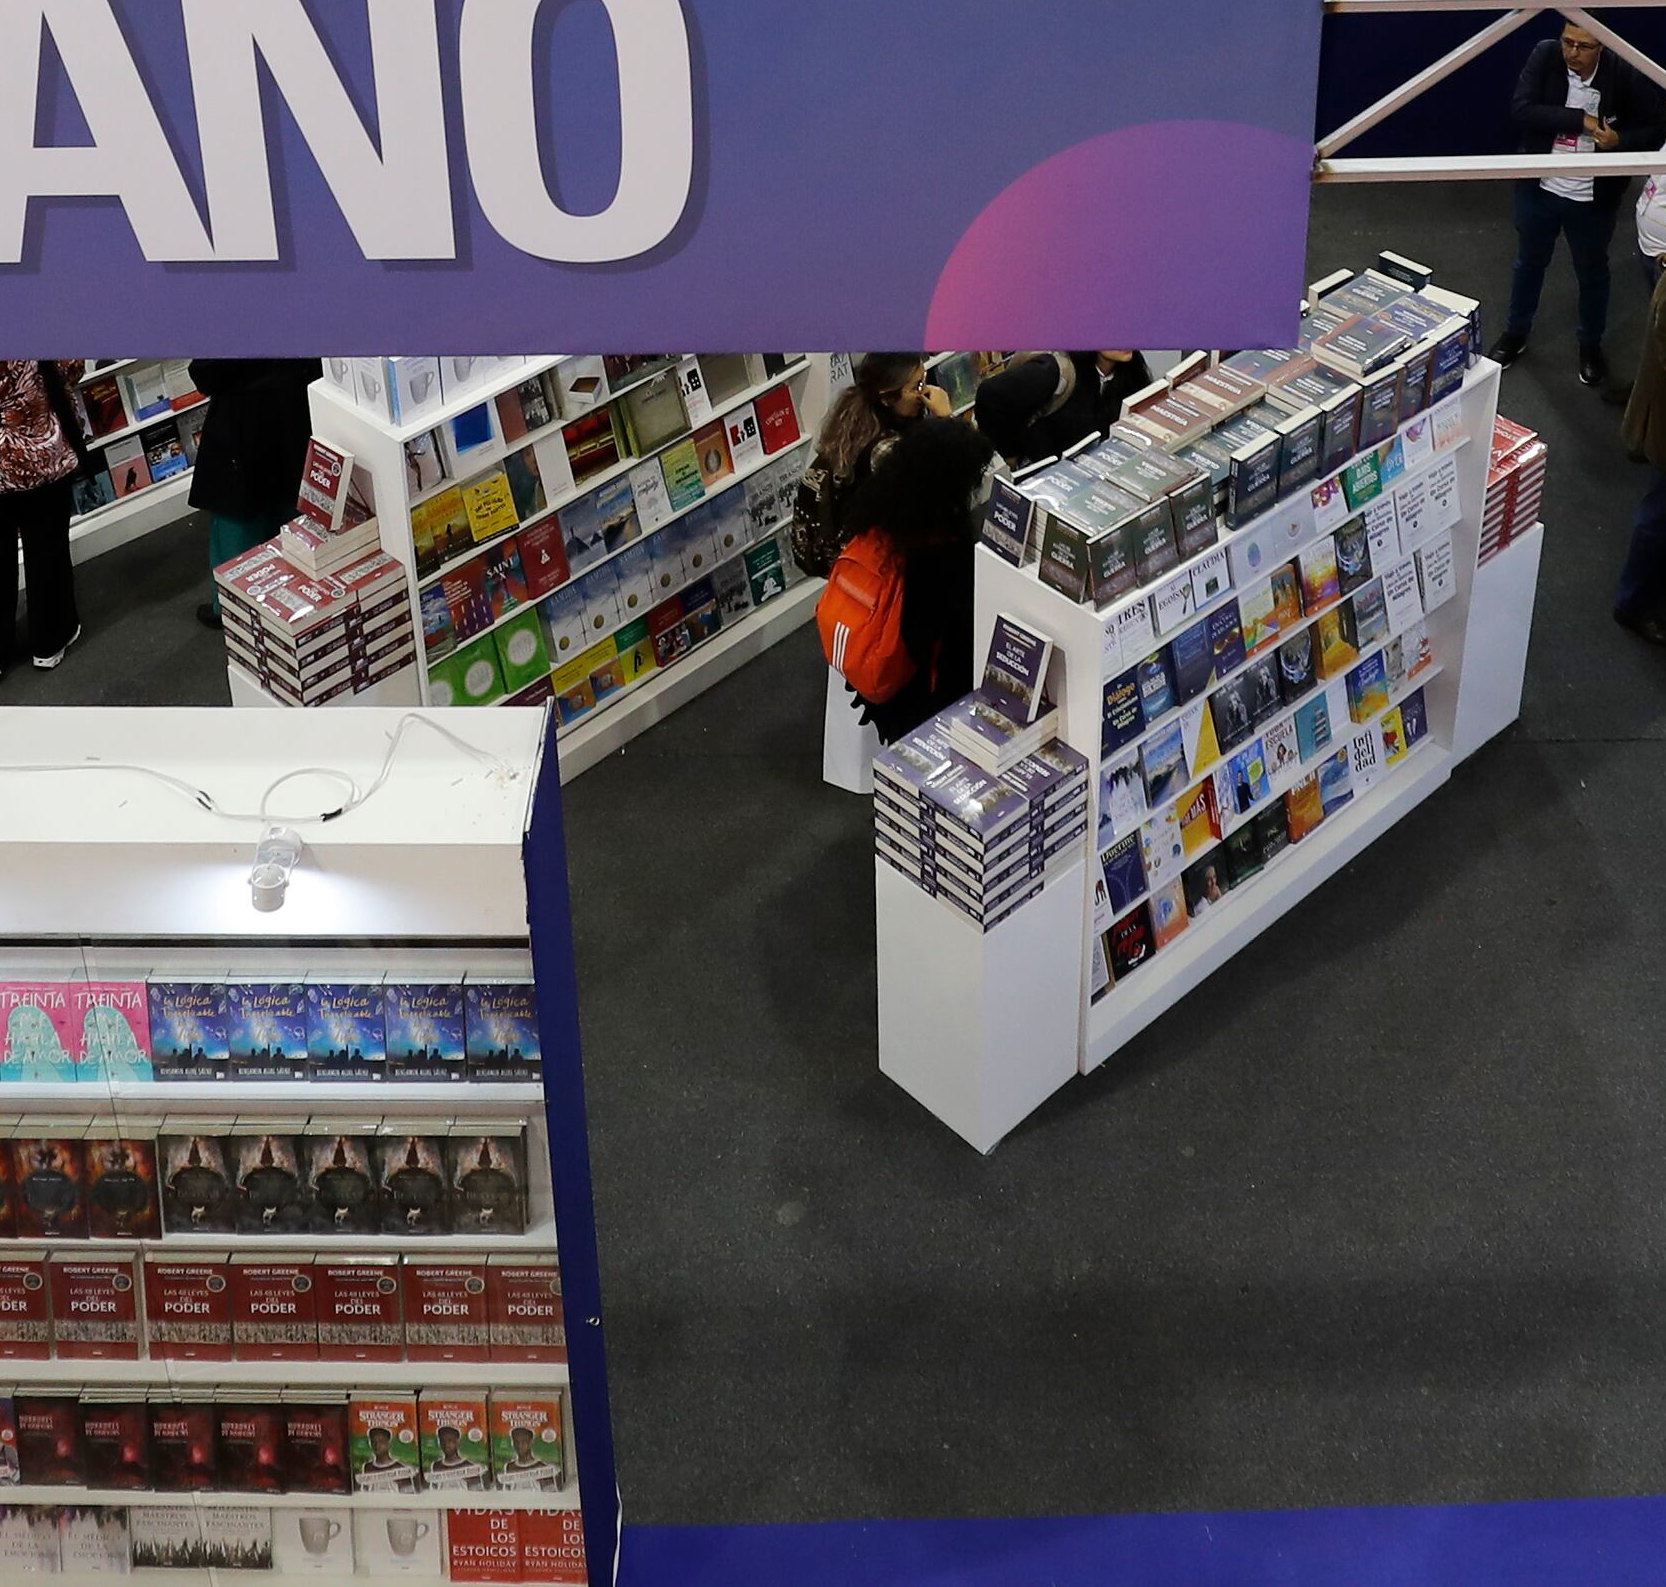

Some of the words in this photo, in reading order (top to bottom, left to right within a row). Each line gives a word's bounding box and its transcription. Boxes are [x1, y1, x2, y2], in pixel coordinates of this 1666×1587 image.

[0, 989, 67, 1010] TREINTA
[187, 1268, 214, 1276] GREENE
[163, 1301, 211, 1315] PODER
[452, 1545, 517, 1558] ESTOICOS
